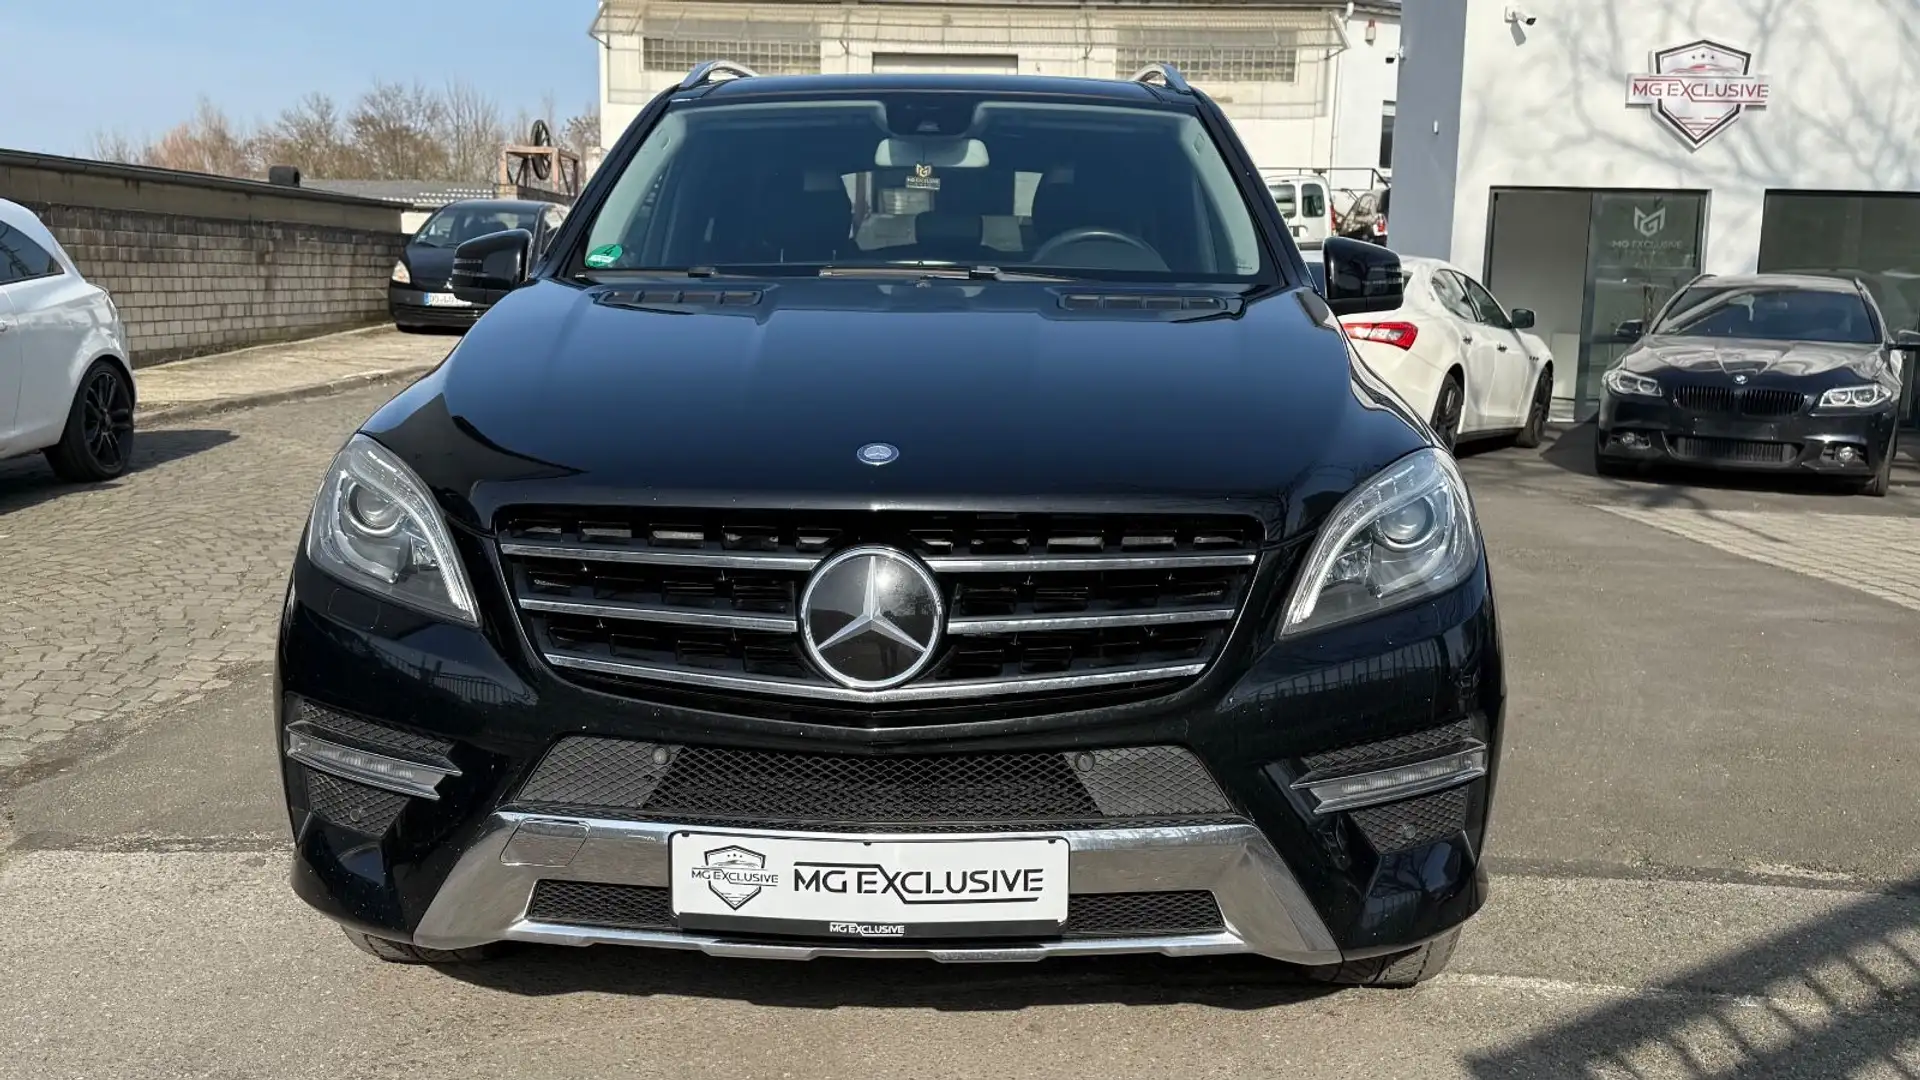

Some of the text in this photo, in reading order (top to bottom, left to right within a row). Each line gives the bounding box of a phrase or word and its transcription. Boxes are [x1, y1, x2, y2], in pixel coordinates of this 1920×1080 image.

[1632, 81, 1769, 99] MG EXCLUSIVE
[692, 869, 779, 884] MG EXCLUSIVE
[794, 866, 1044, 897] MG EXCLUSIVE
[829, 923, 905, 935] MG EXCLUSIVE
